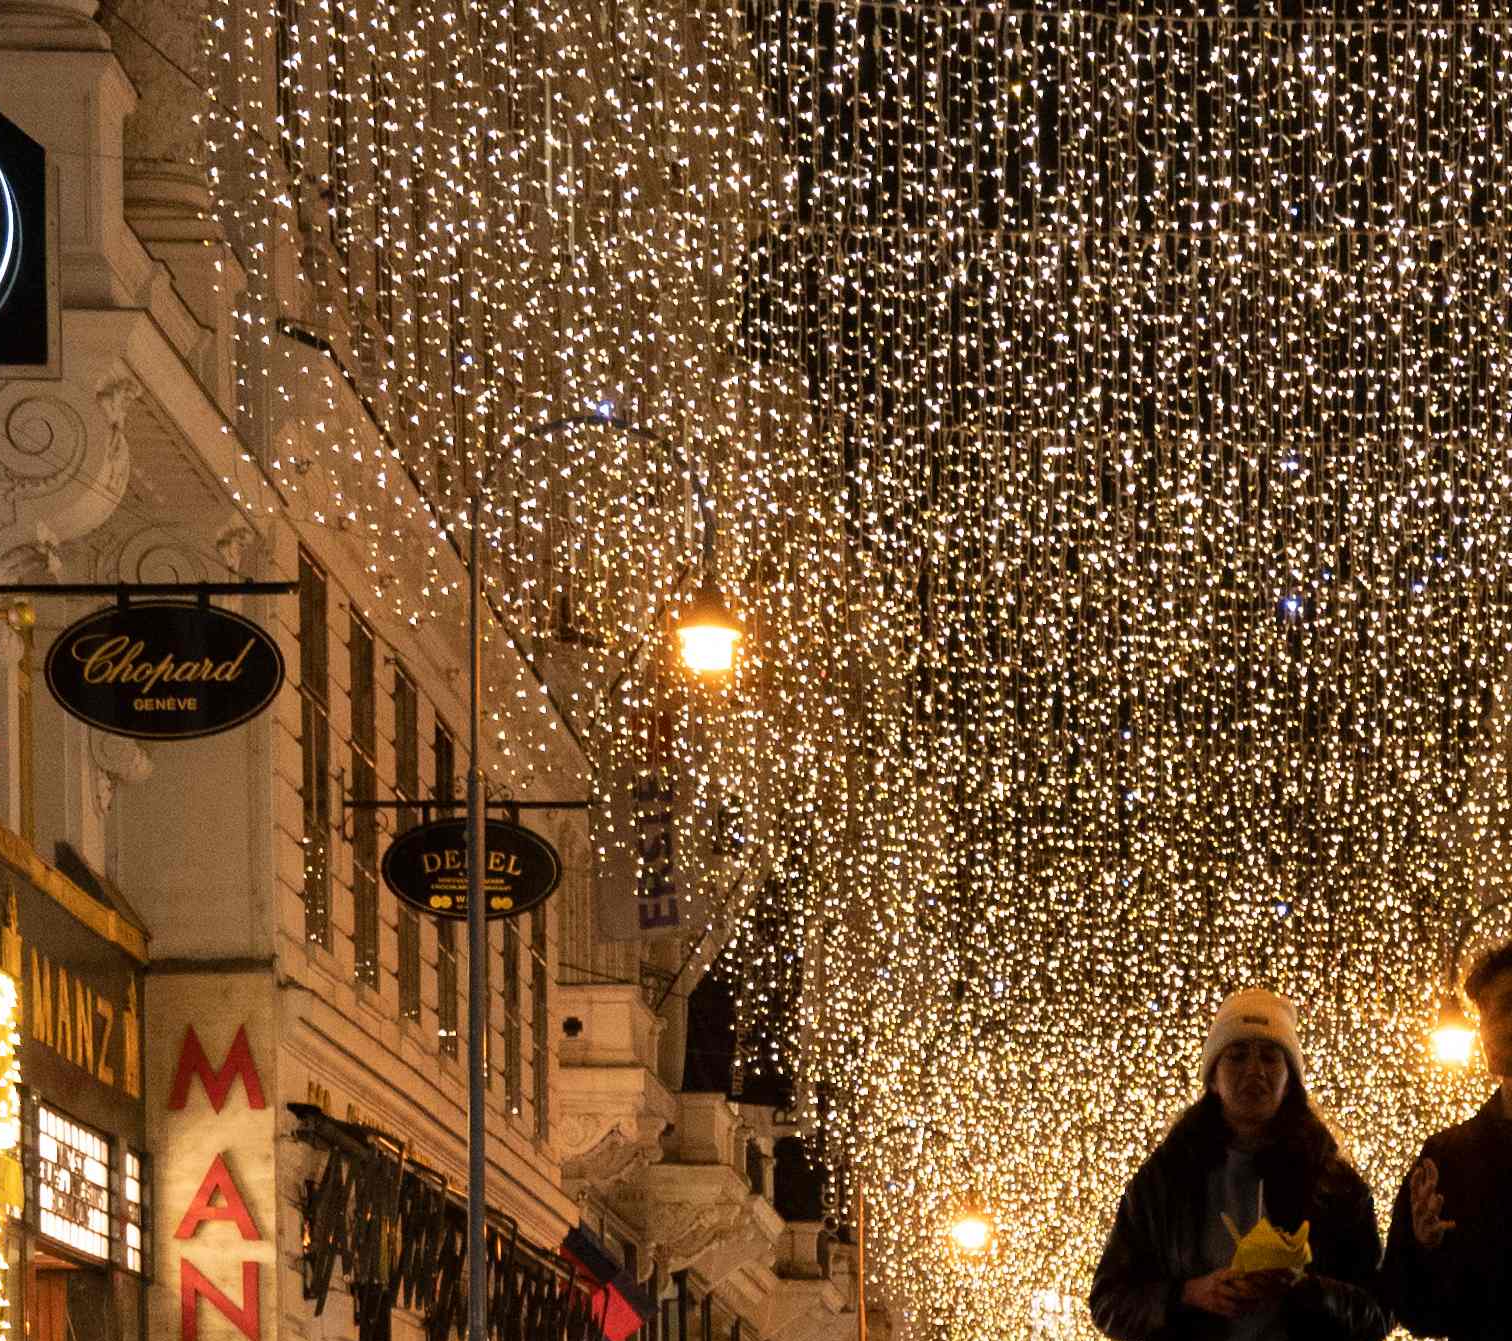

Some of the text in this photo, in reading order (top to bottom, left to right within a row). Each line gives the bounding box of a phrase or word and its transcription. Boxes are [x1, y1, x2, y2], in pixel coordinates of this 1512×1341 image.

[71, 634, 258, 694] Chopard
[424, 850, 521, 876] DEEL
[31, 944, 115, 1088] MANZ
